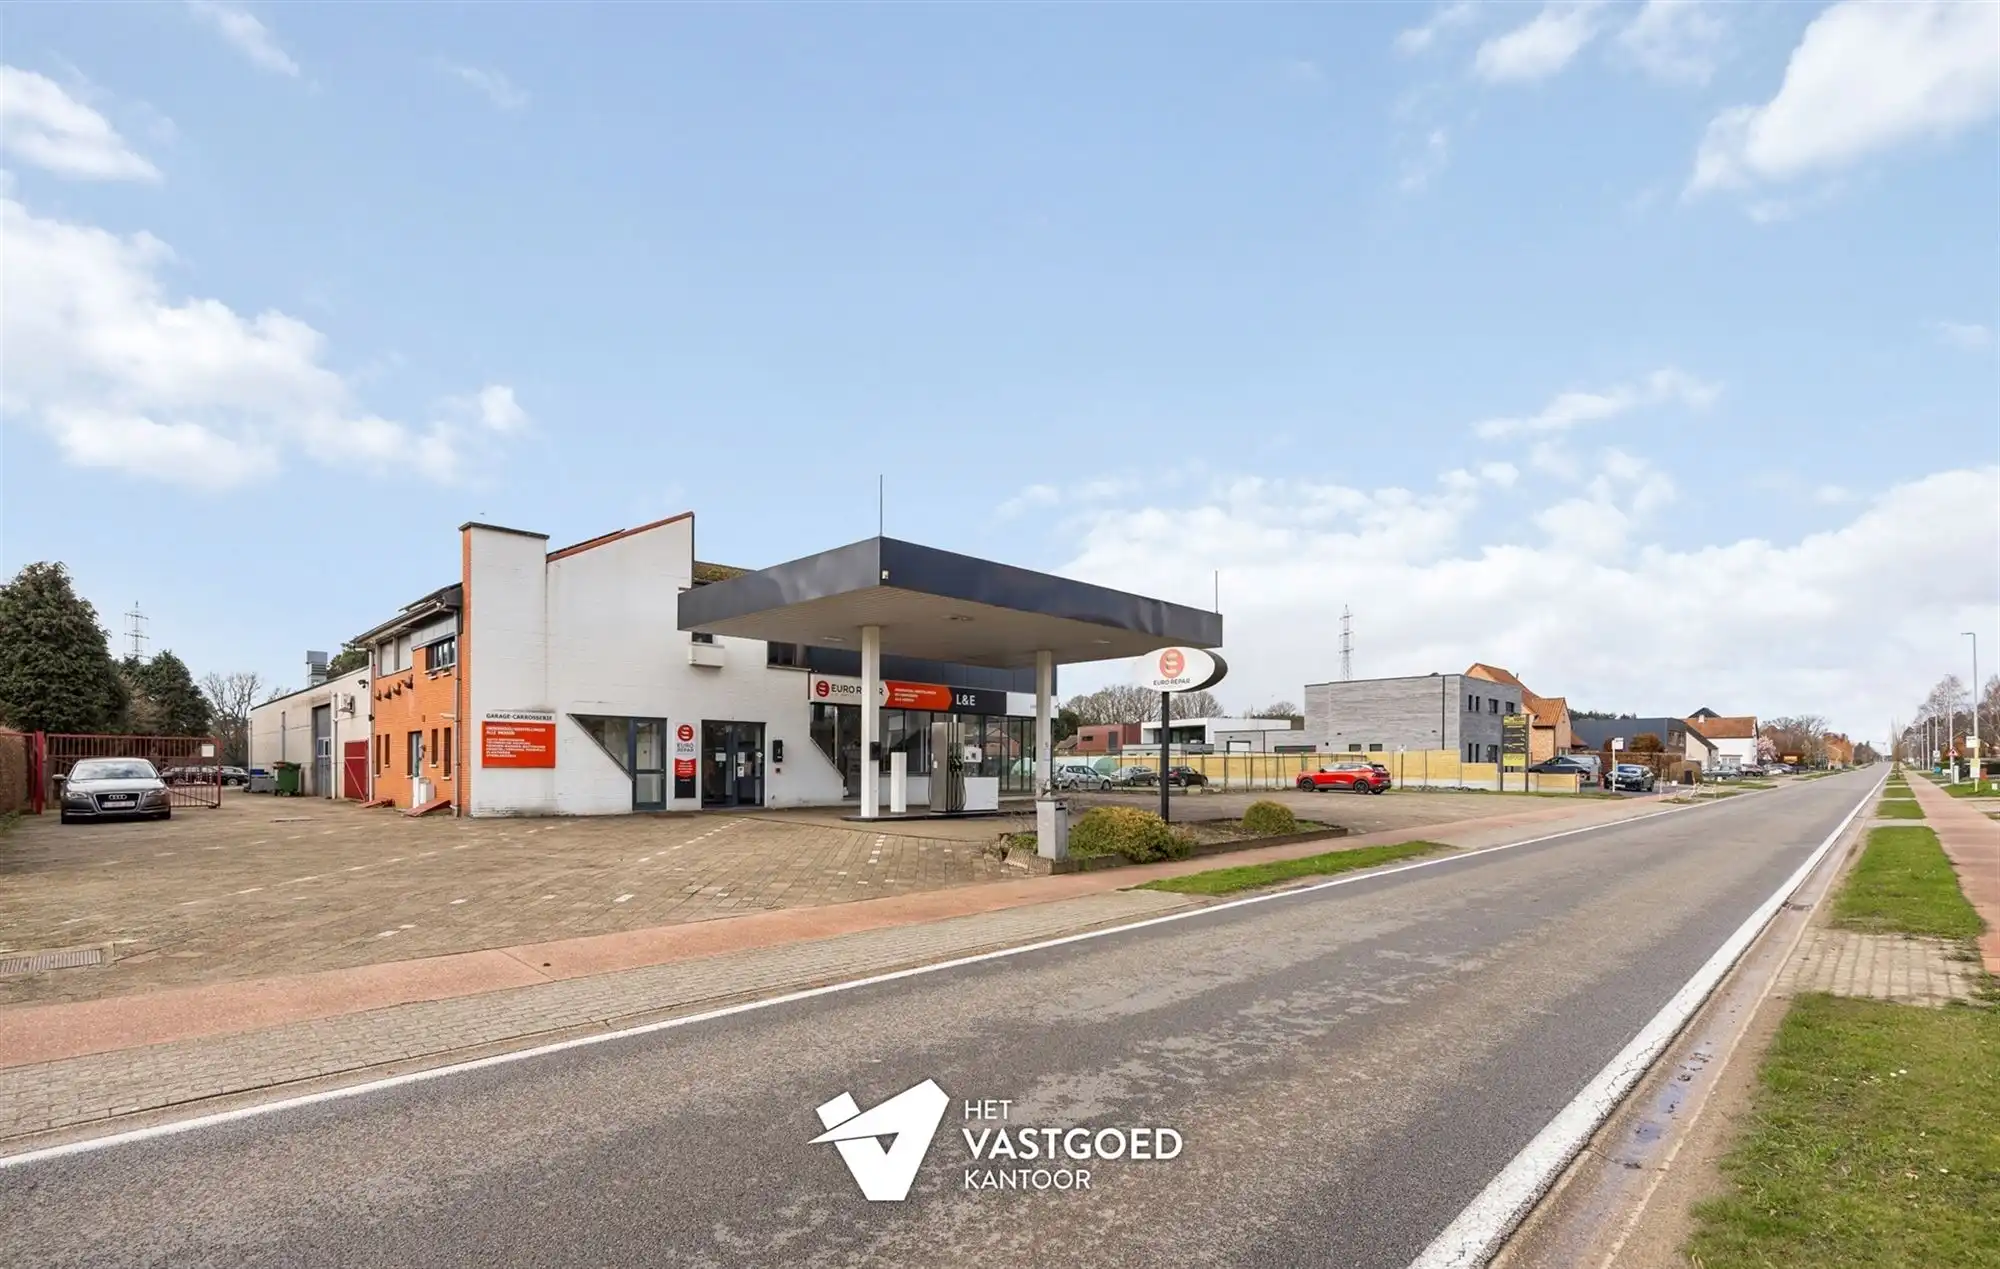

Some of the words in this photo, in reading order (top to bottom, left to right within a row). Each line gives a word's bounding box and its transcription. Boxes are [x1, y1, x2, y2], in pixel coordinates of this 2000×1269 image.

[831, 684, 855, 693] EURO
[956, 693, 976, 706] L&E
[486, 713, 553, 721] GARAGE-CARROSSERIE
